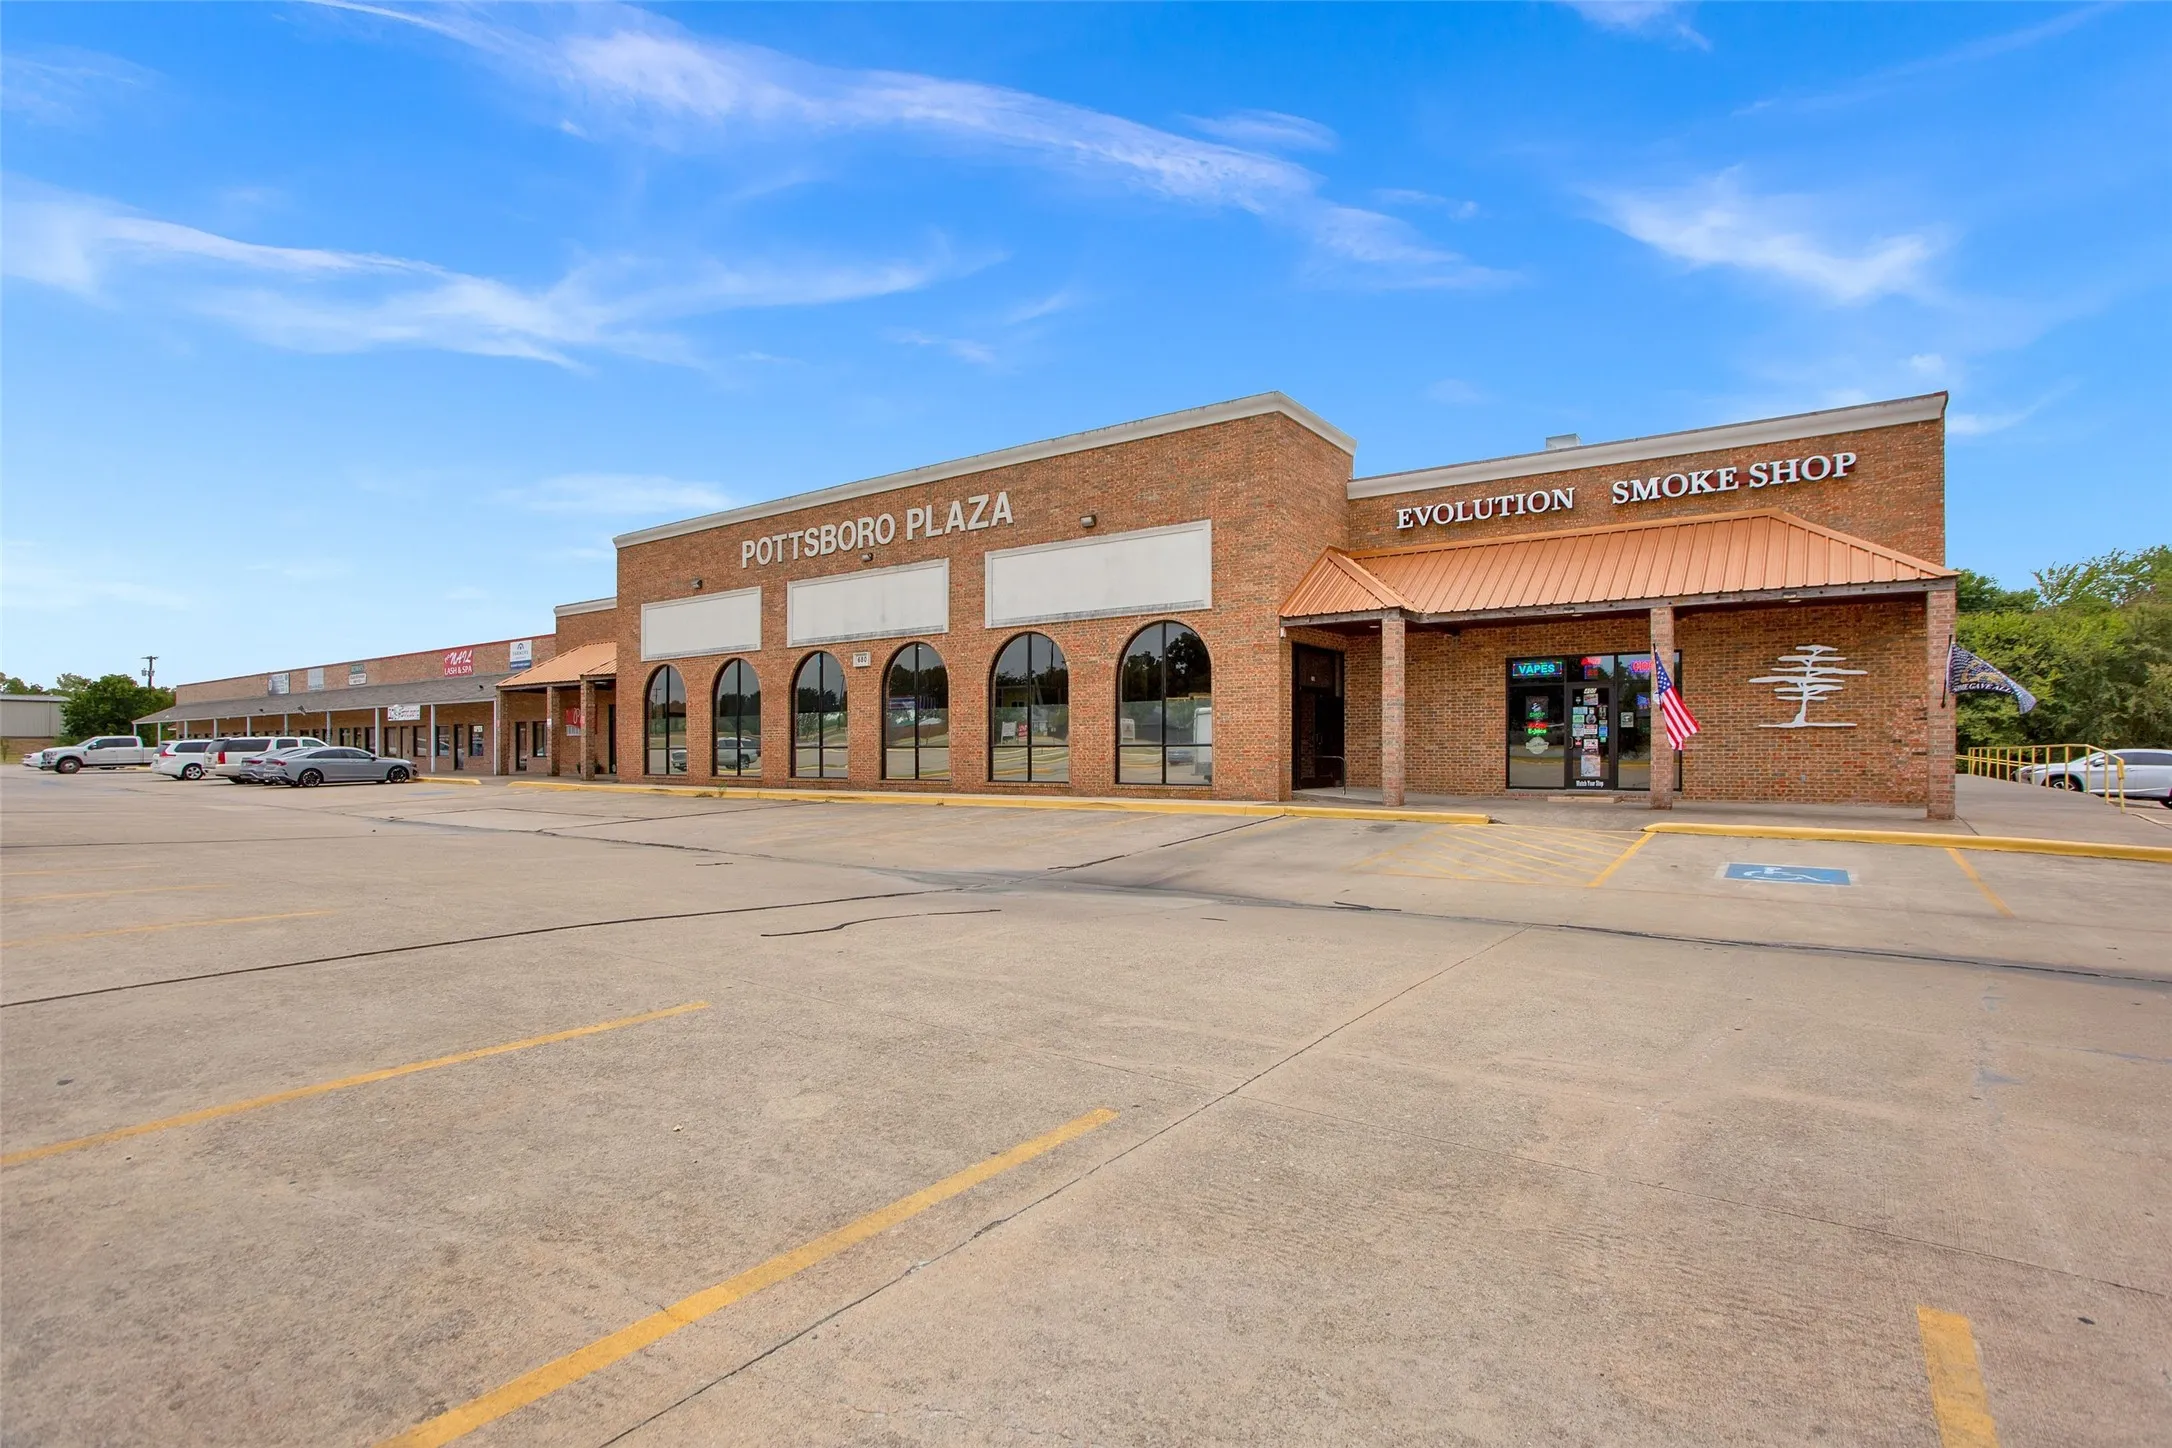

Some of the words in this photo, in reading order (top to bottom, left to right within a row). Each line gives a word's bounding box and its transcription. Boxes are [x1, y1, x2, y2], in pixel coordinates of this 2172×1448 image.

[1396, 487, 1575, 529] EVOLUTION
[1611, 466, 1739, 505] SMOKE
[1749, 452, 1857, 490] SHOP
[741, 513, 896, 569] POTTSBORO
[906, 491, 1014, 541] PLAZA
[444, 666, 457, 675] LASH
[463, 665, 473, 673] SPA
[1518, 664, 1555, 674] VAPES
[1969, 682, 1992, 690] GAVE
[1596, 780, 1604, 788] Step
